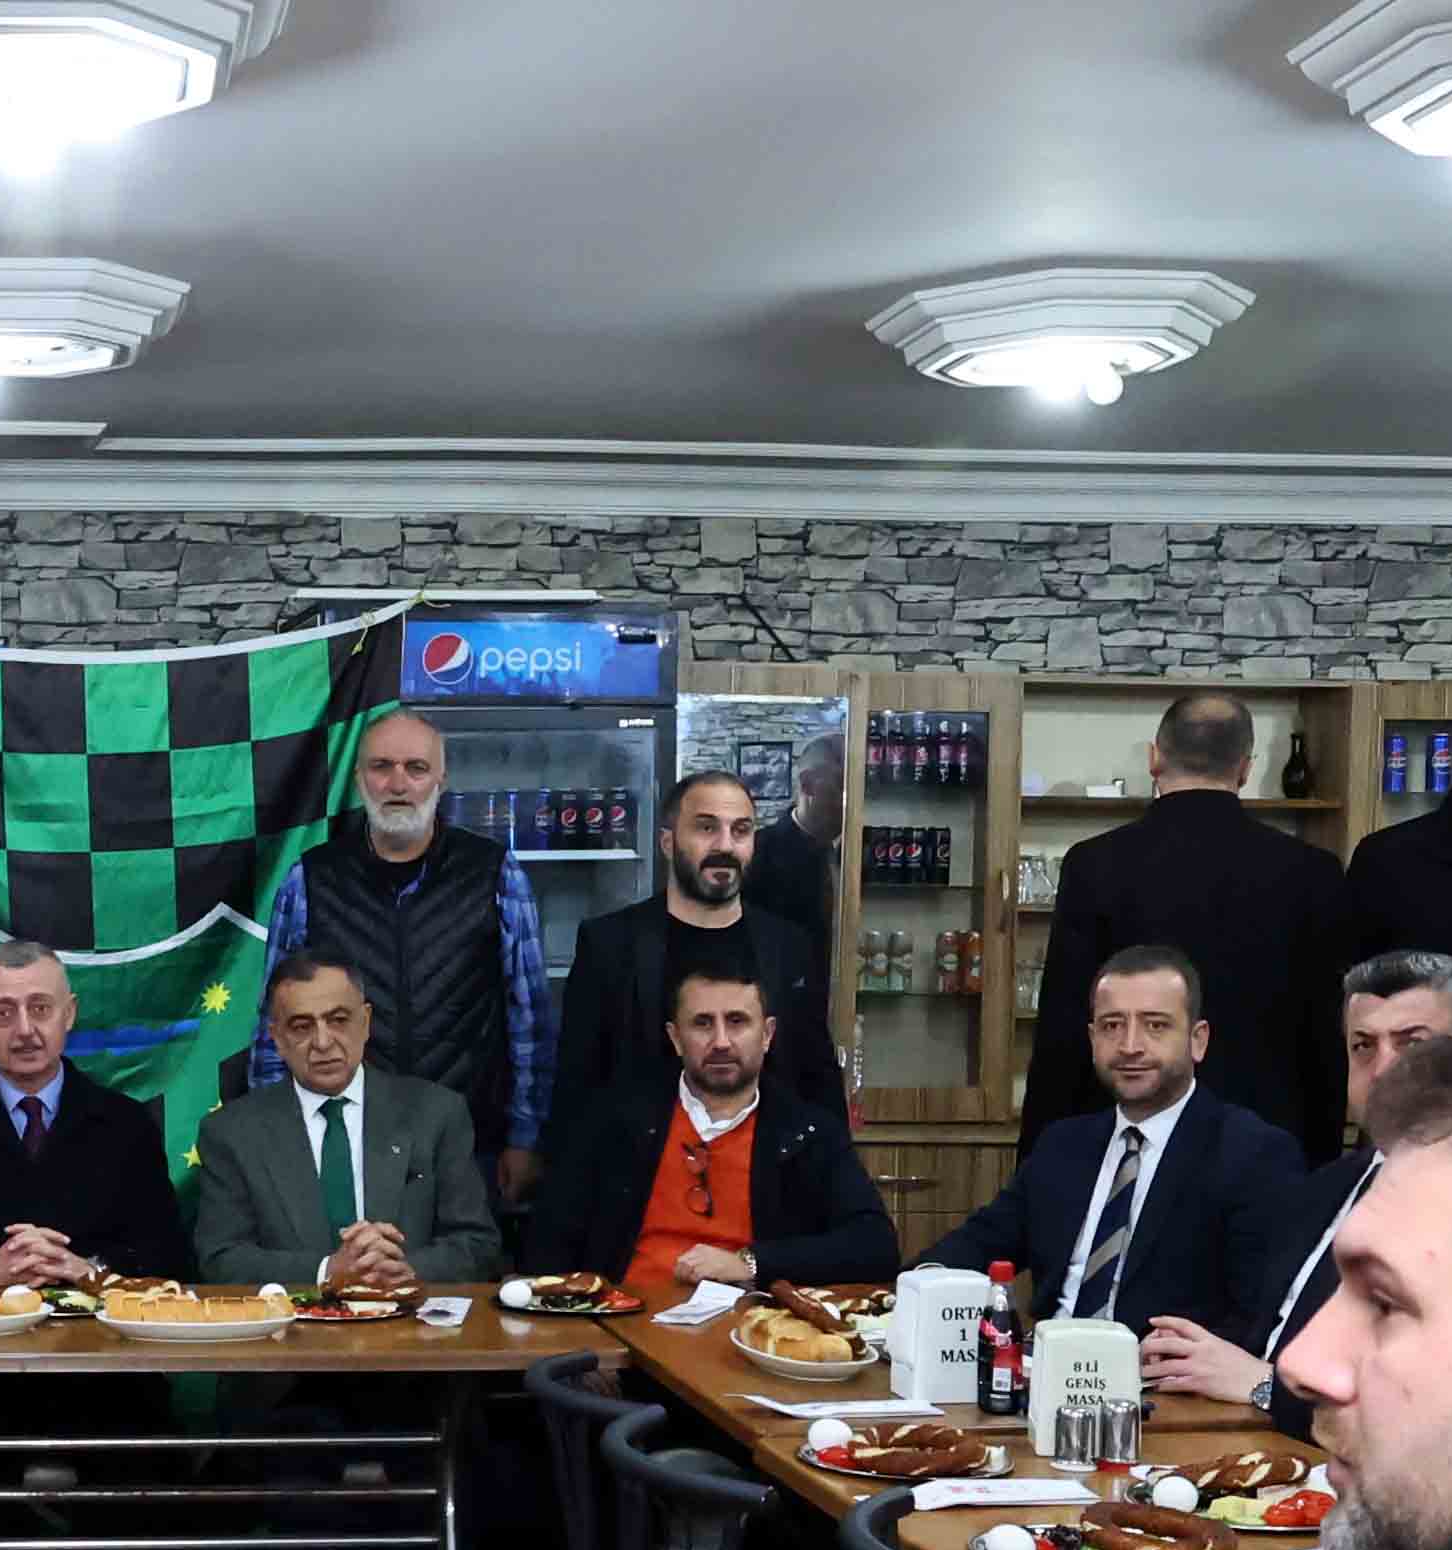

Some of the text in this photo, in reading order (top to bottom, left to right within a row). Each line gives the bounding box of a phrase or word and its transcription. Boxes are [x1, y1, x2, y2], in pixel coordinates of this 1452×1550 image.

[480, 640, 582, 678] pepsi
[960, 1328, 968, 1341] 1
[941, 1349, 976, 1363] MAS
[1066, 1393, 1105, 1406] MASA
